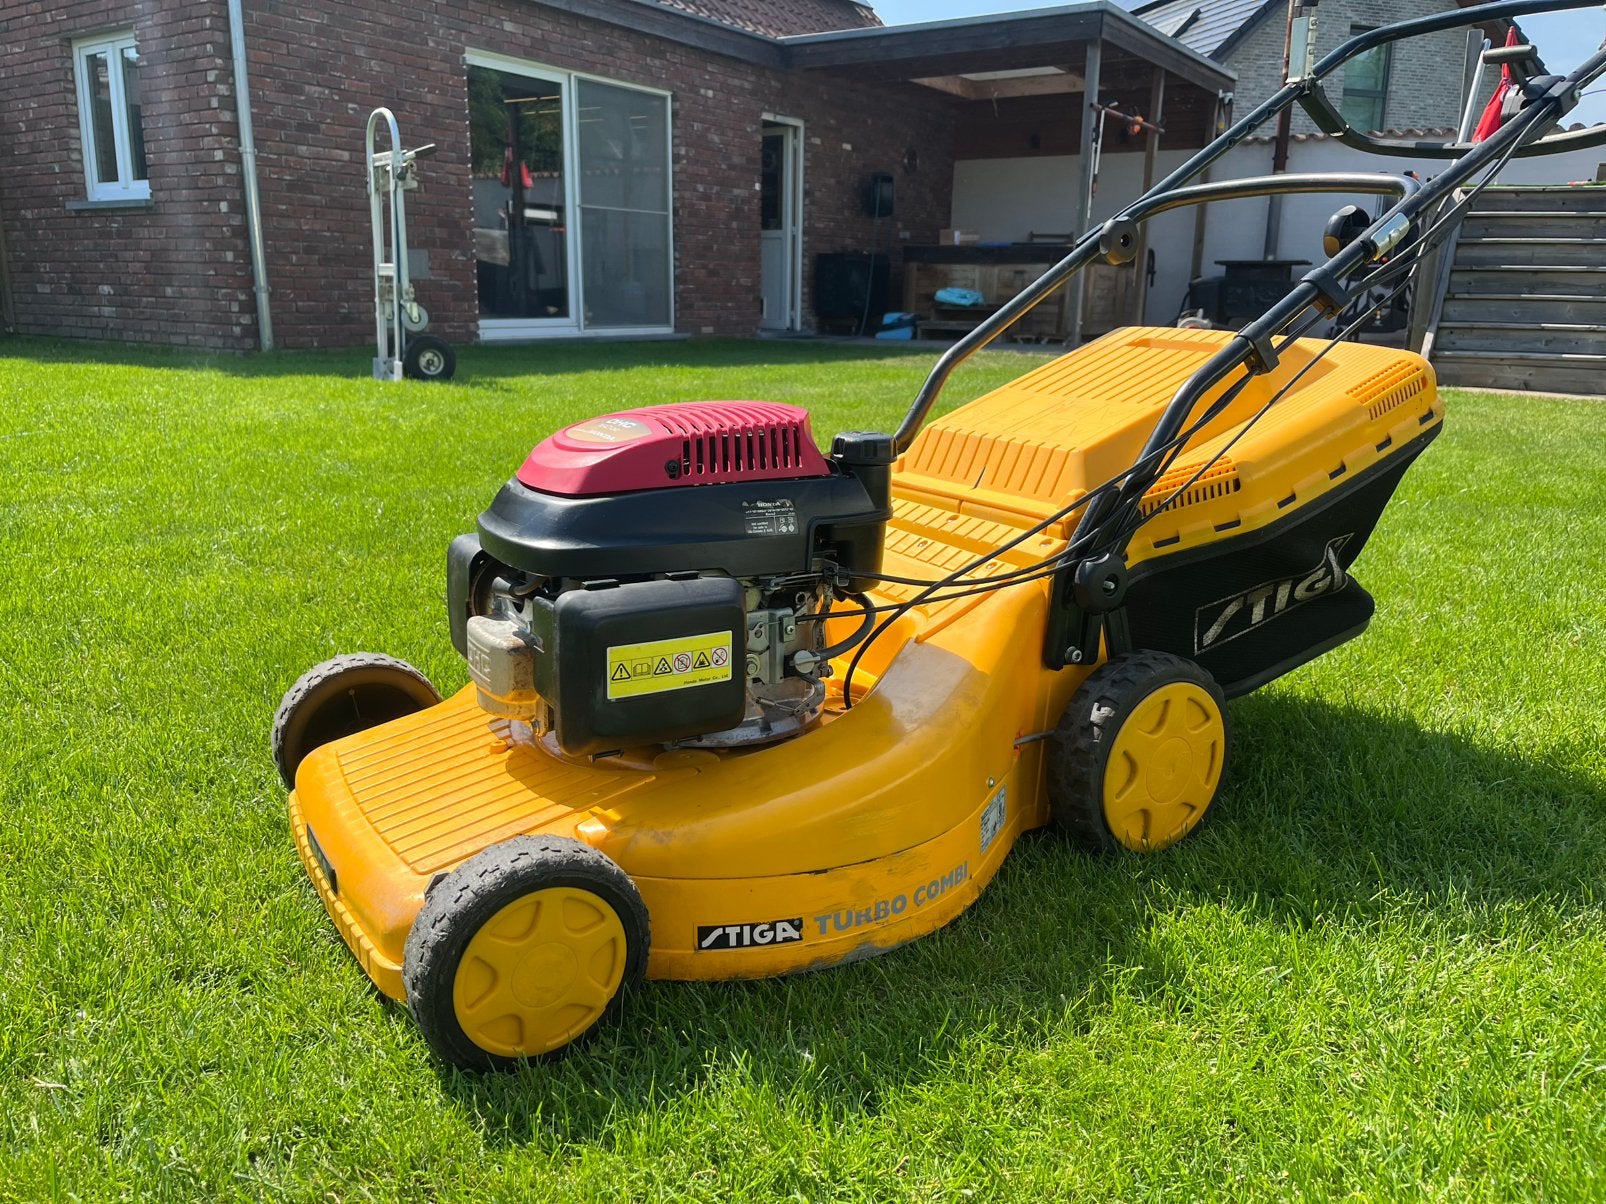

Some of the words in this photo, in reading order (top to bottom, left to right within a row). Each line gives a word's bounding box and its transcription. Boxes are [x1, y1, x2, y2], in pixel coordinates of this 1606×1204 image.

[701, 921, 800, 947] STIGA
[814, 893, 908, 936] TURBO
[913, 860, 969, 907] COMBI
